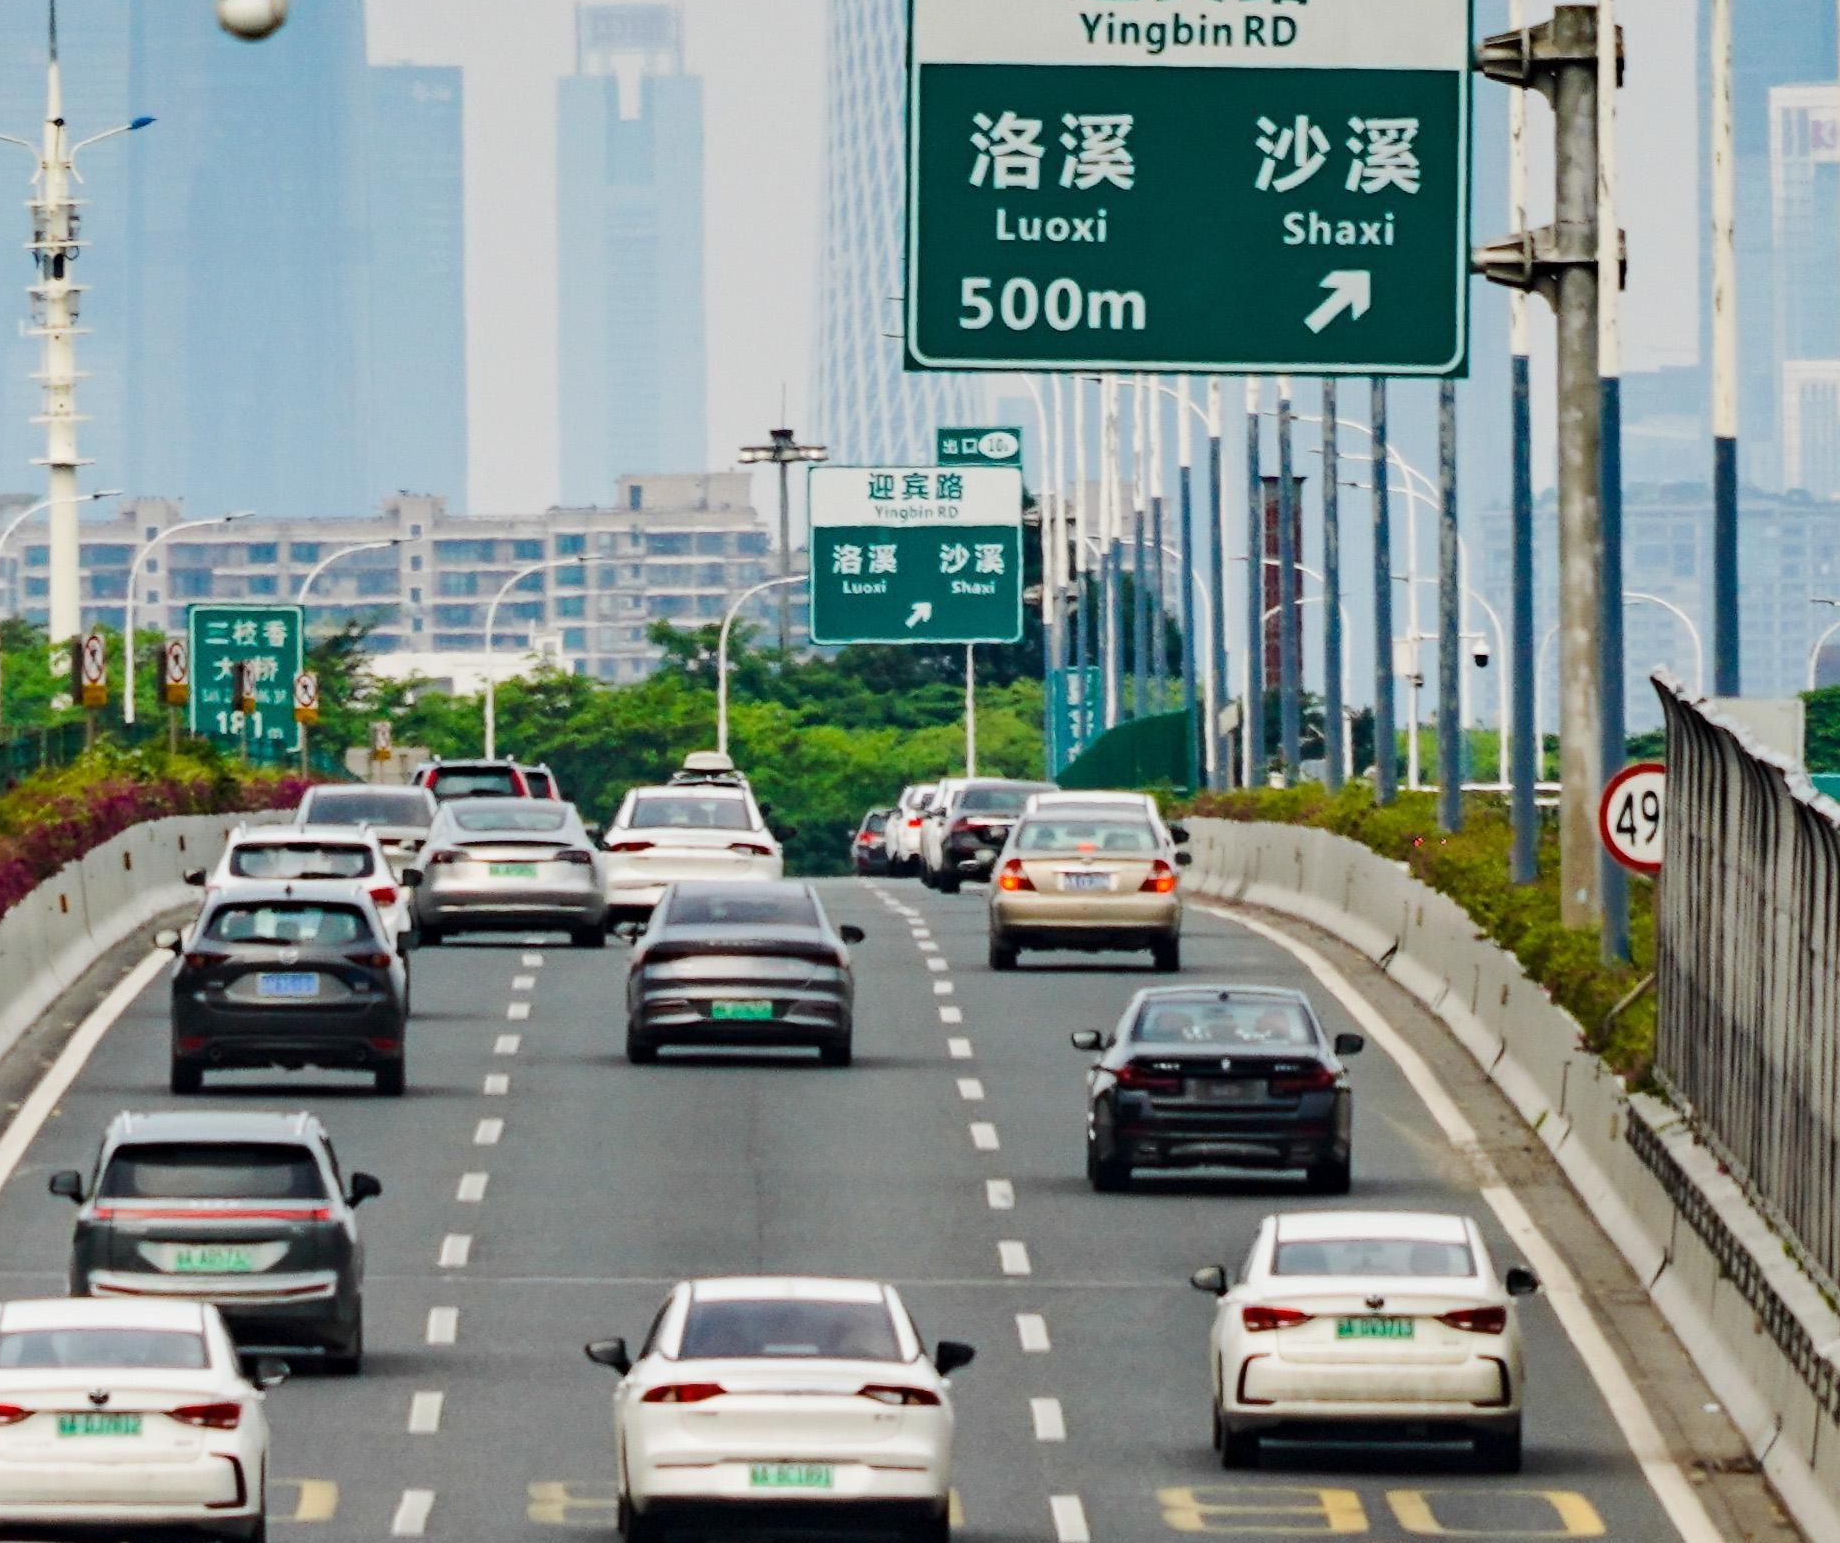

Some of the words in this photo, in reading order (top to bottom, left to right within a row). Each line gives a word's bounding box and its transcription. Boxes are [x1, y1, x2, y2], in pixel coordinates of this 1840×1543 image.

[1080, 13, 1233, 54] Yingbin
[1244, 16, 1297, 48] RD
[969, 111, 1136, 191] 洛溪
[1254, 115, 1421, 194] 沙溪
[996, 208, 1109, 243] Luoxi
[1283, 212, 1395, 246] Shaxi
[959, 276, 1147, 332] 500m
[942, 438, 979, 455] 出口
[867, 472, 963, 501] 迎宾路
[874, 505, 934, 523] Yingbin
[937, 505, 959, 519] RD
[832, 543, 898, 575] 洛溪
[939, 543, 1005, 575] 沙溪
[842, 578, 887, 594] Luoxi
[951, 579, 996, 594] Shaxi
